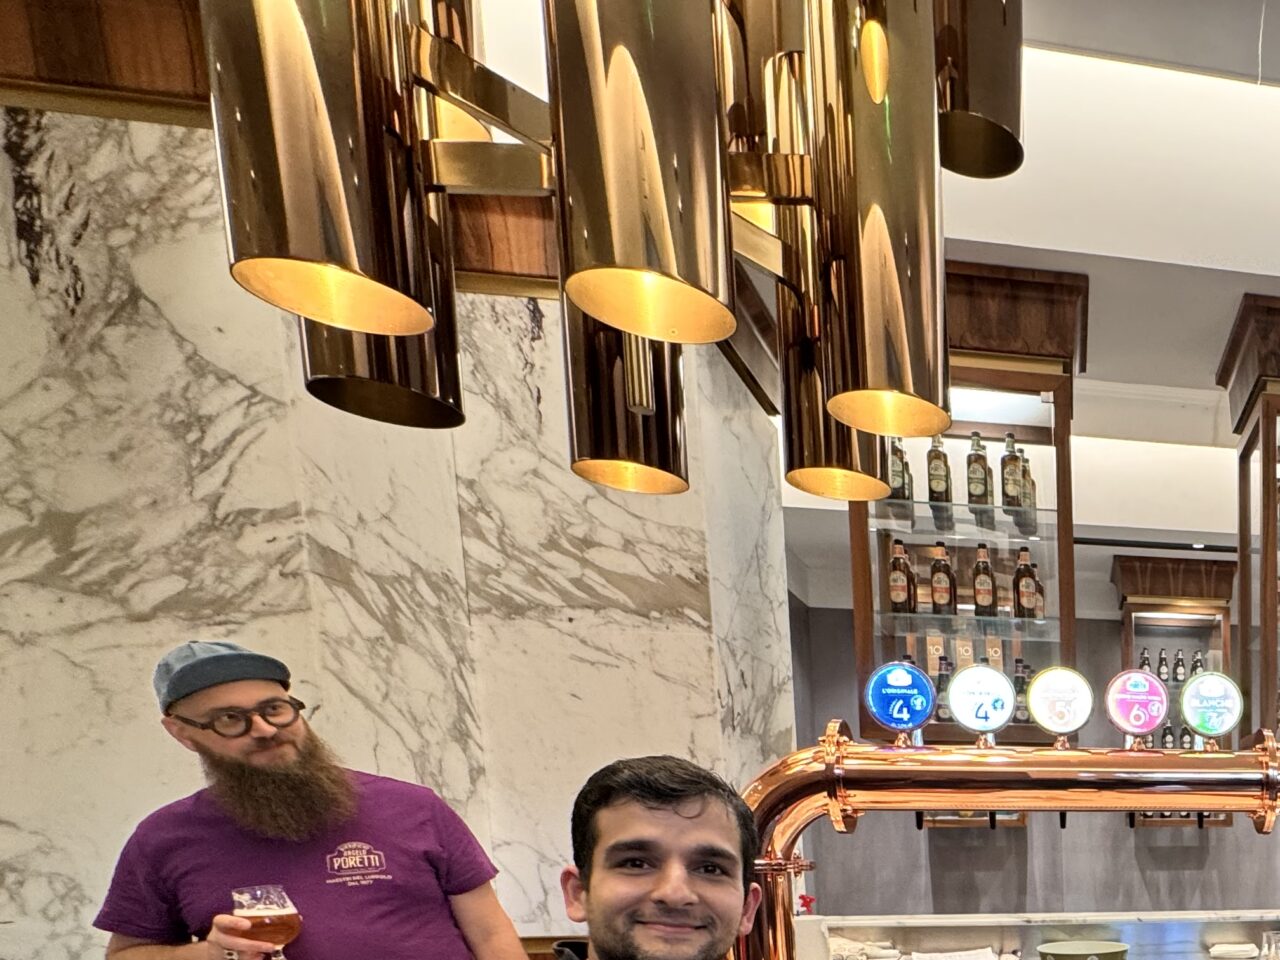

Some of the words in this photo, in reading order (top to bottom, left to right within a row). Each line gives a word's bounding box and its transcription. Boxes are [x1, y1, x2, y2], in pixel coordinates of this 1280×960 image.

[929, 645, 942, 655] 10
[958, 646, 972, 656] 10
[987, 647, 1001, 657] 10
[893, 699, 910, 721] 4
[975, 702, 990, 722] 4
[1130, 704, 1145, 726] 6
[333, 855, 380, 870] PORETTI
